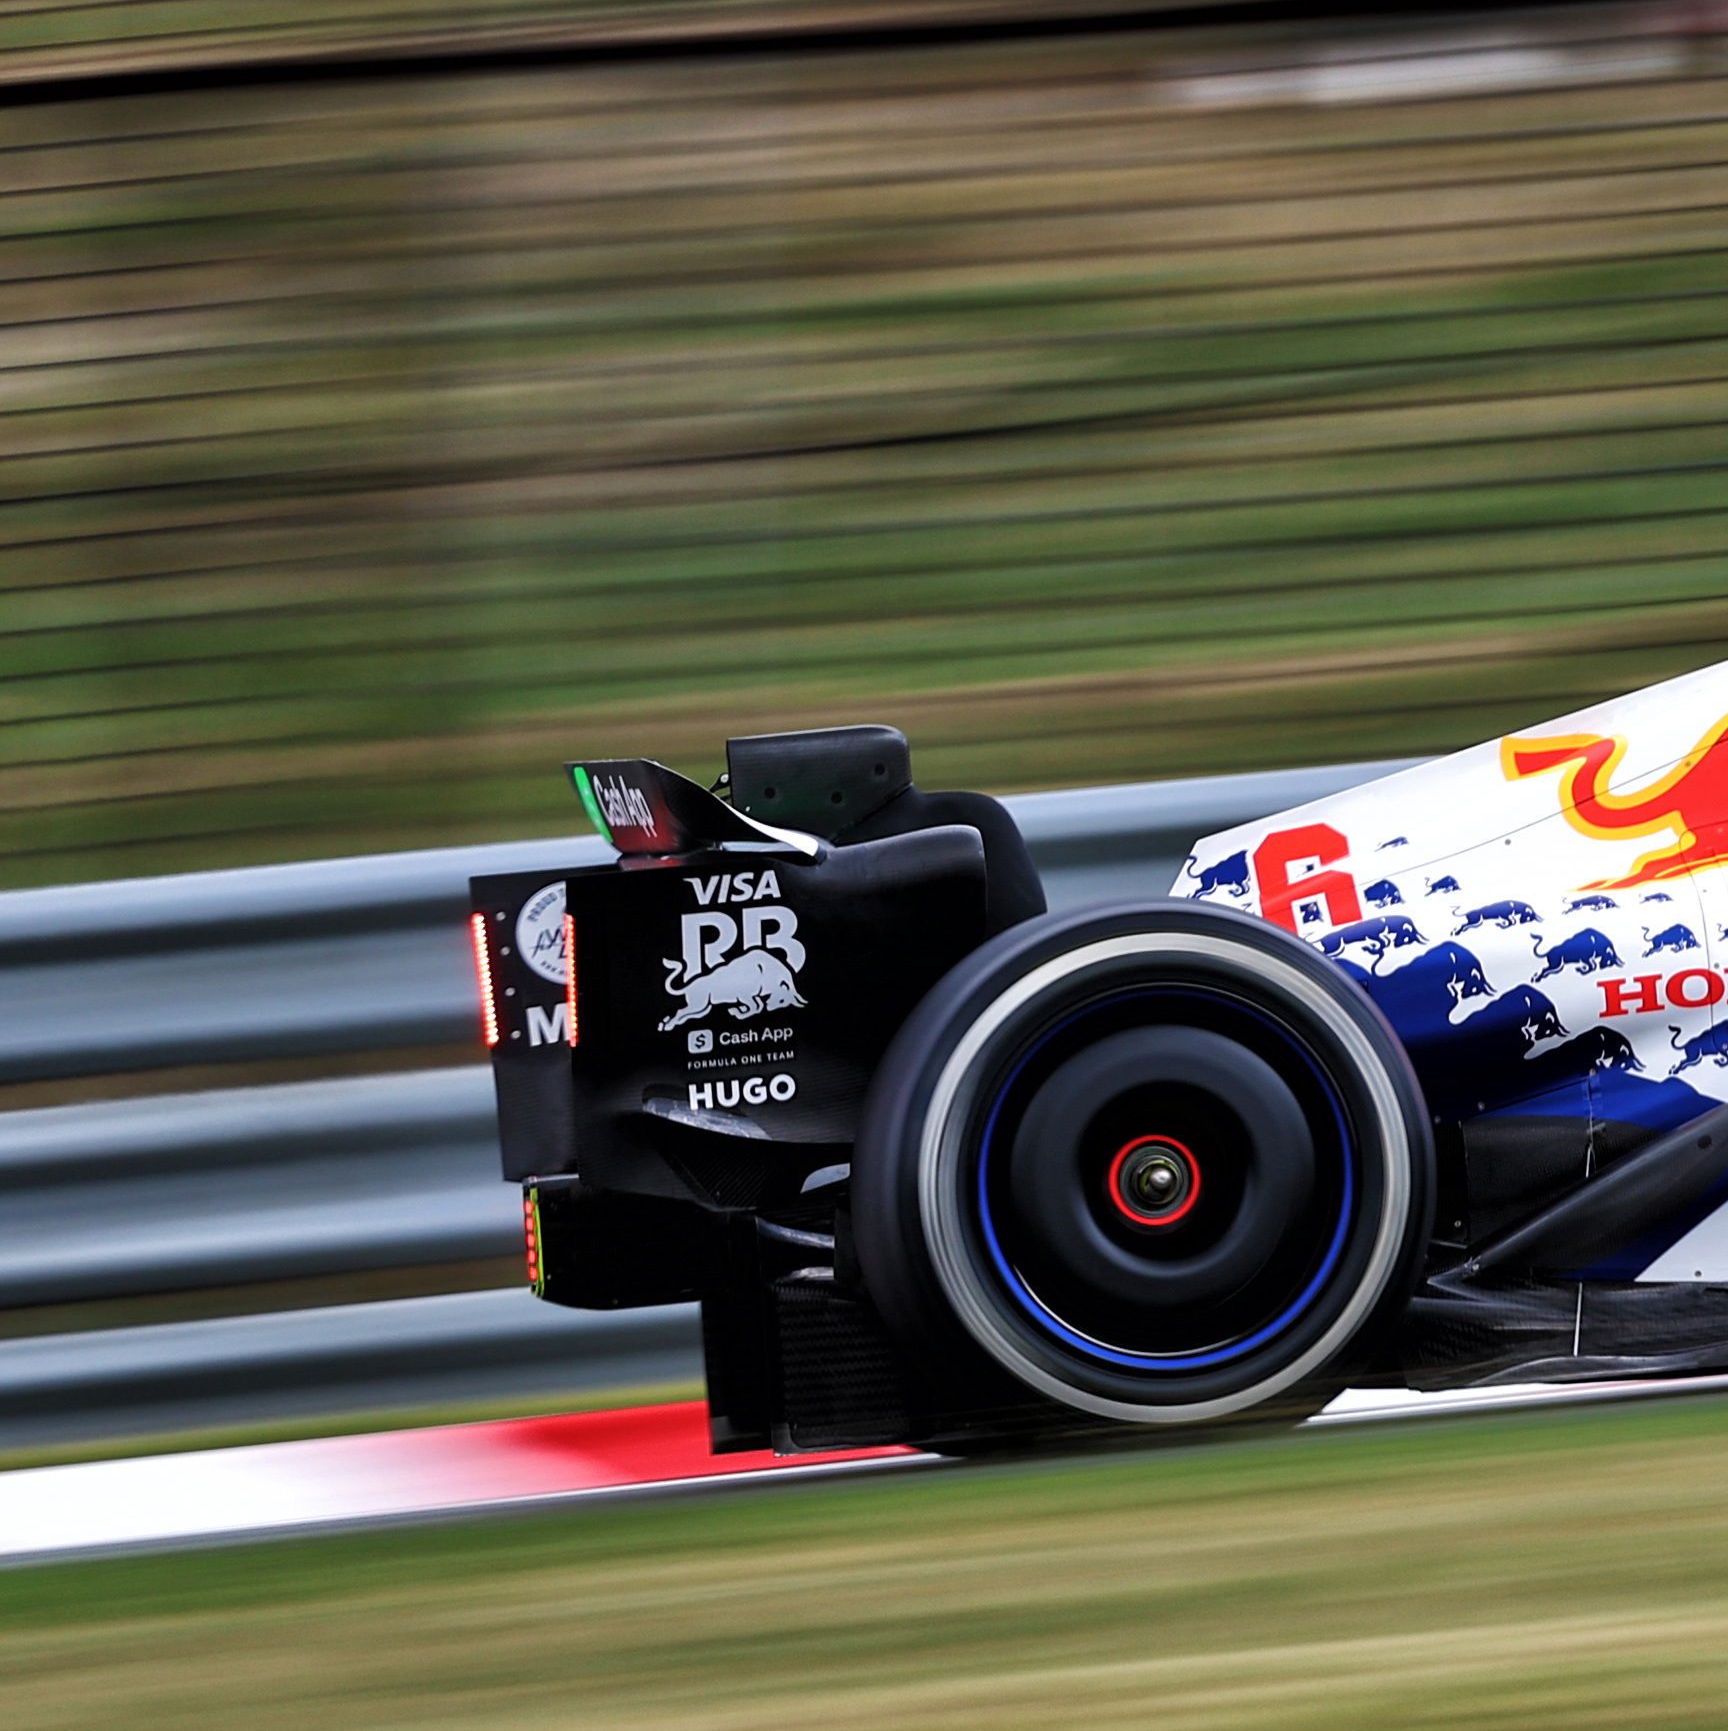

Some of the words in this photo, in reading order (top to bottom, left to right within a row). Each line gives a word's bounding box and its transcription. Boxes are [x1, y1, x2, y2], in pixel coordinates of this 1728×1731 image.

[593, 775, 633, 827] Cash
[619, 775, 658, 838] App
[682, 870, 782, 905] VISA
[1253, 822, 1363, 935] 6
[719, 1030, 758, 1045] Cash
[761, 1027, 793, 1043] App
[687, 1057, 737, 1070] FORMULA
[741, 1053, 763, 1065] ONE
[767, 1050, 795, 1062] TEAM
[688, 1073, 796, 1111] HUGO
